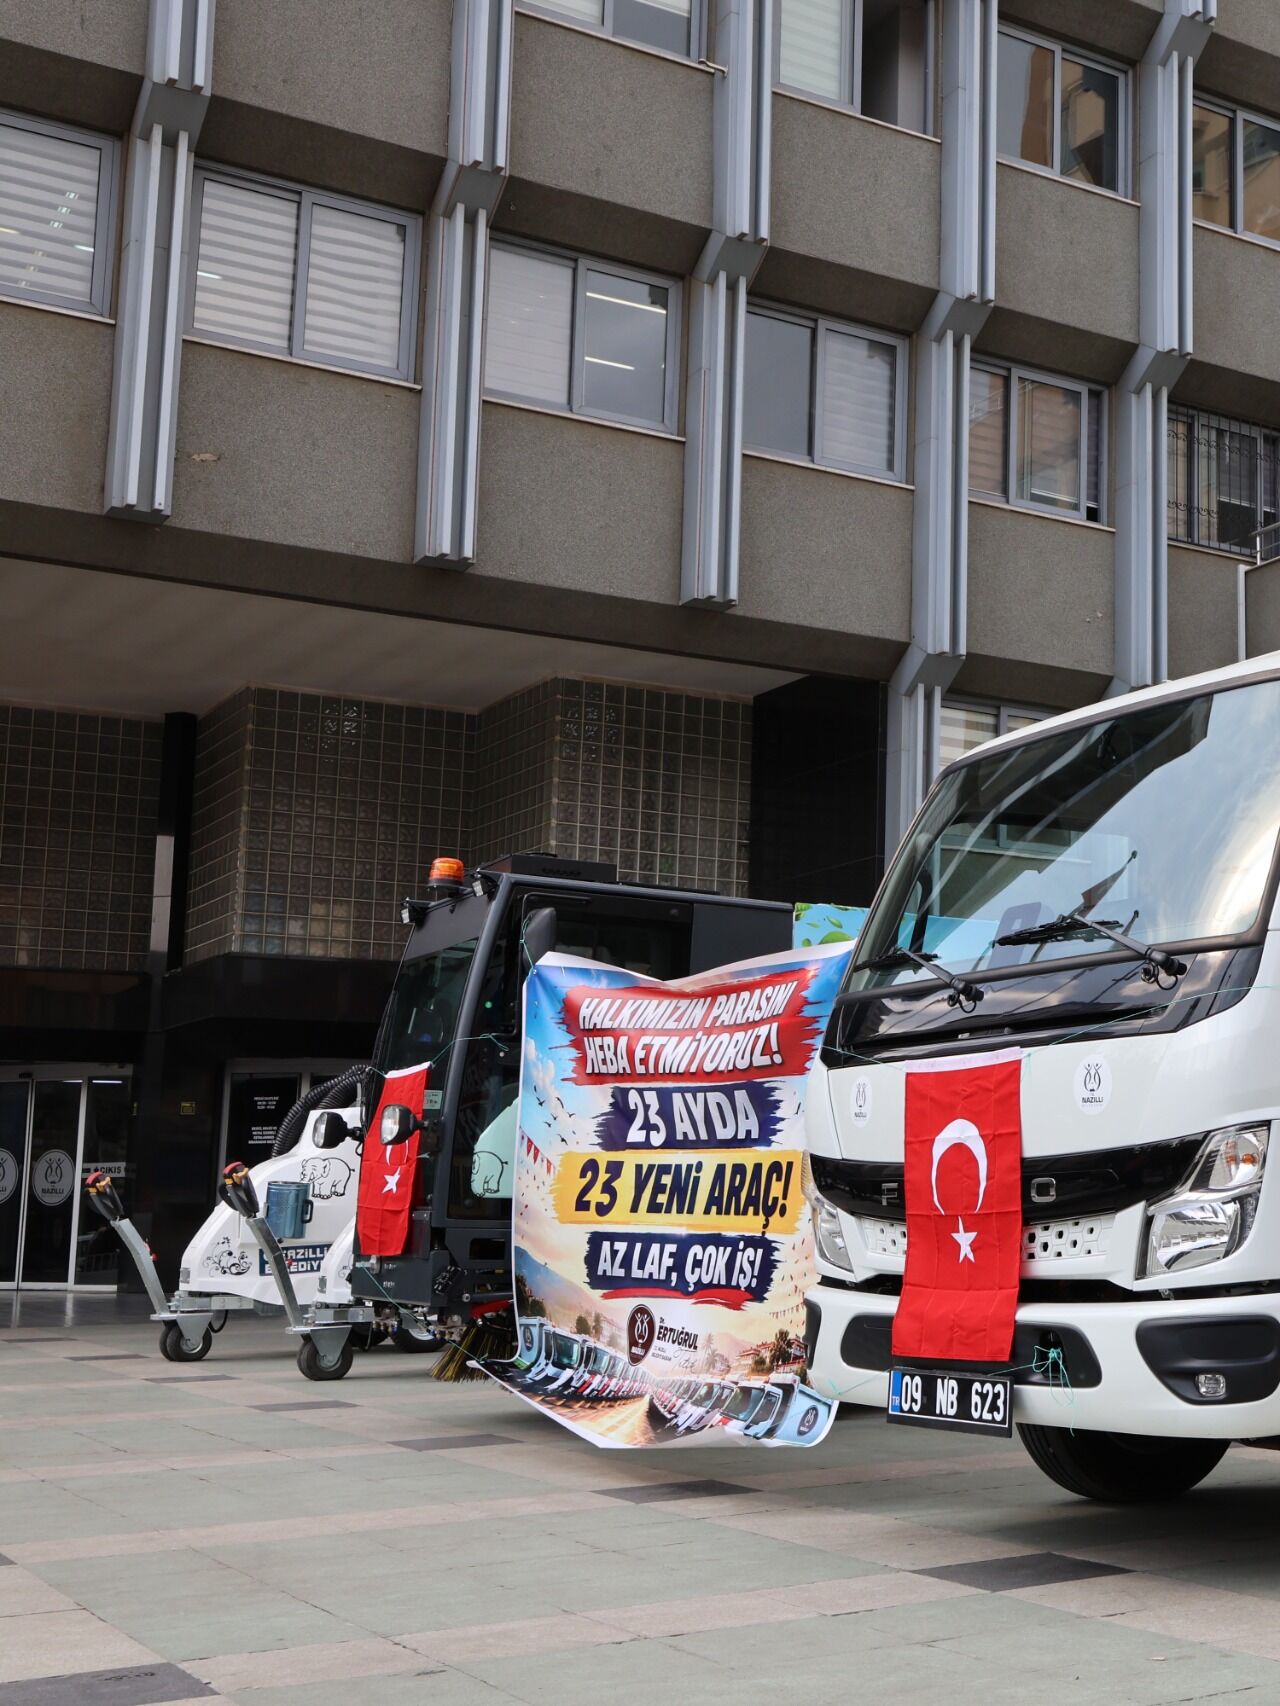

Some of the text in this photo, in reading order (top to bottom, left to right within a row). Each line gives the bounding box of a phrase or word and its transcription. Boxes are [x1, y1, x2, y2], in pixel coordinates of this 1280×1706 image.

[579, 981, 799, 1030] HALKIMIZIN PARASINI
[584, 1035, 631, 1074] HEBA
[626, 1089, 759, 1147] 23 AYDA
[574, 1158, 625, 1217] 23
[703, 1160, 794, 1229] ARAÇ!
[597, 1240, 764, 1292] AZ LAF, ÇOK İŞ!
[656, 1324, 699, 1350] ERTUĞRUL
[891, 1375, 1005, 1422] TR 09 NB 623
